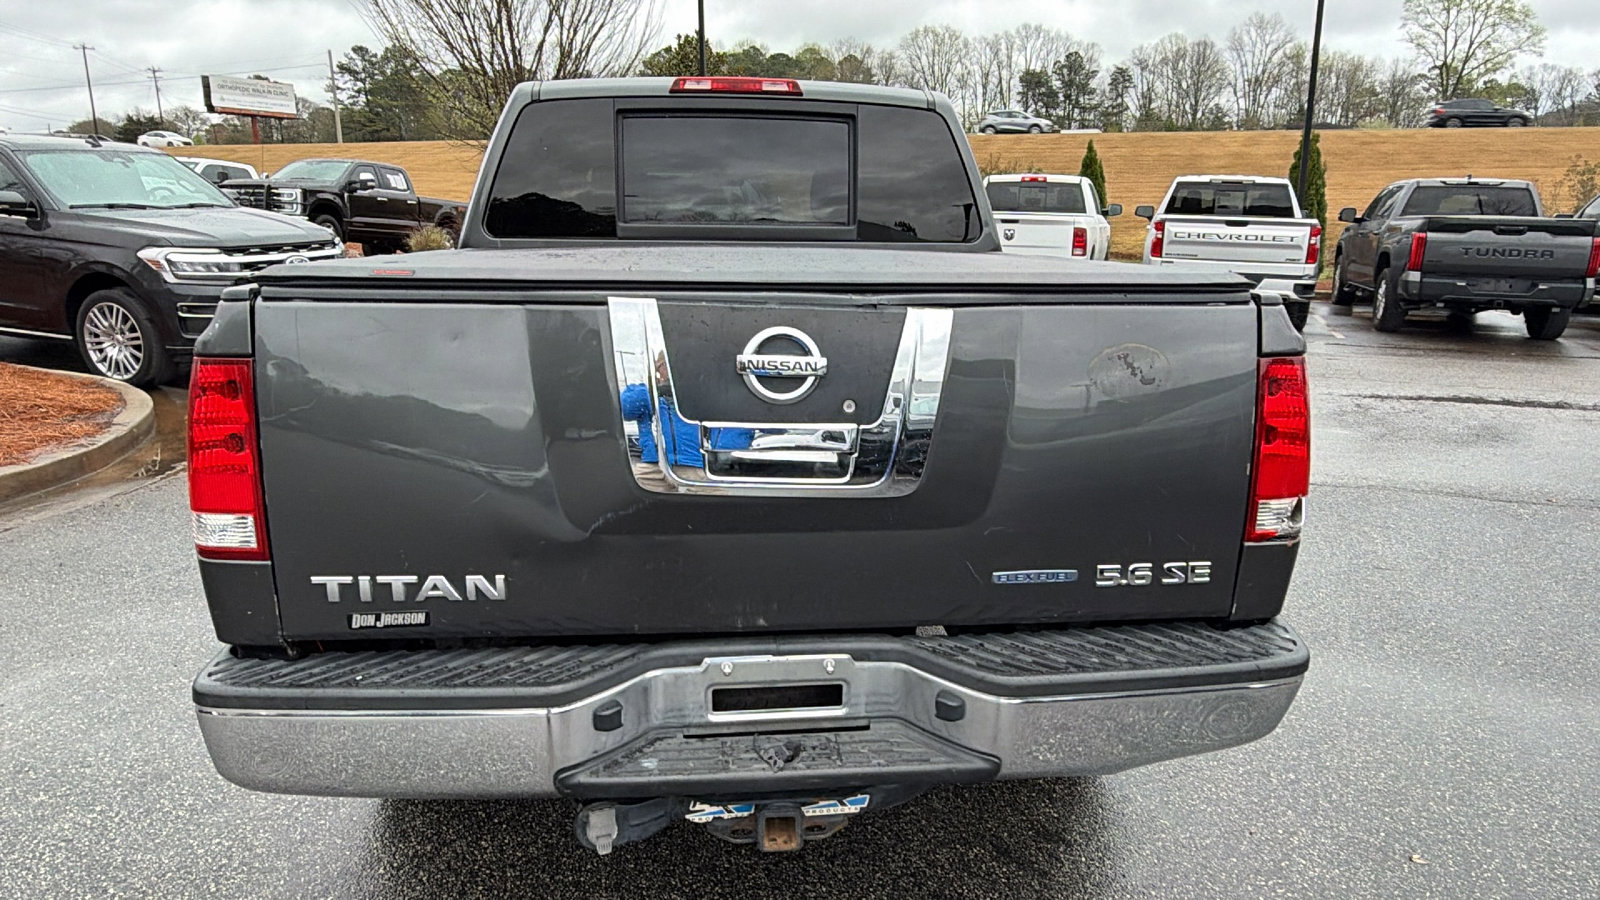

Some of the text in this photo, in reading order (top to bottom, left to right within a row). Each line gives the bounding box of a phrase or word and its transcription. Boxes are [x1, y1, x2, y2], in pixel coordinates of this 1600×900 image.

[217, 84, 250, 93] ORTHOPEDIC
[1174, 232, 1299, 242] CHEVROLET
[1460, 247, 1555, 259] TUNDRA
[747, 360, 817, 372] NISSAN
[997, 572, 1073, 582] FLEX FUEL
[1096, 561, 1212, 587] 5.6 SE
[310, 575, 506, 602] TITAN
